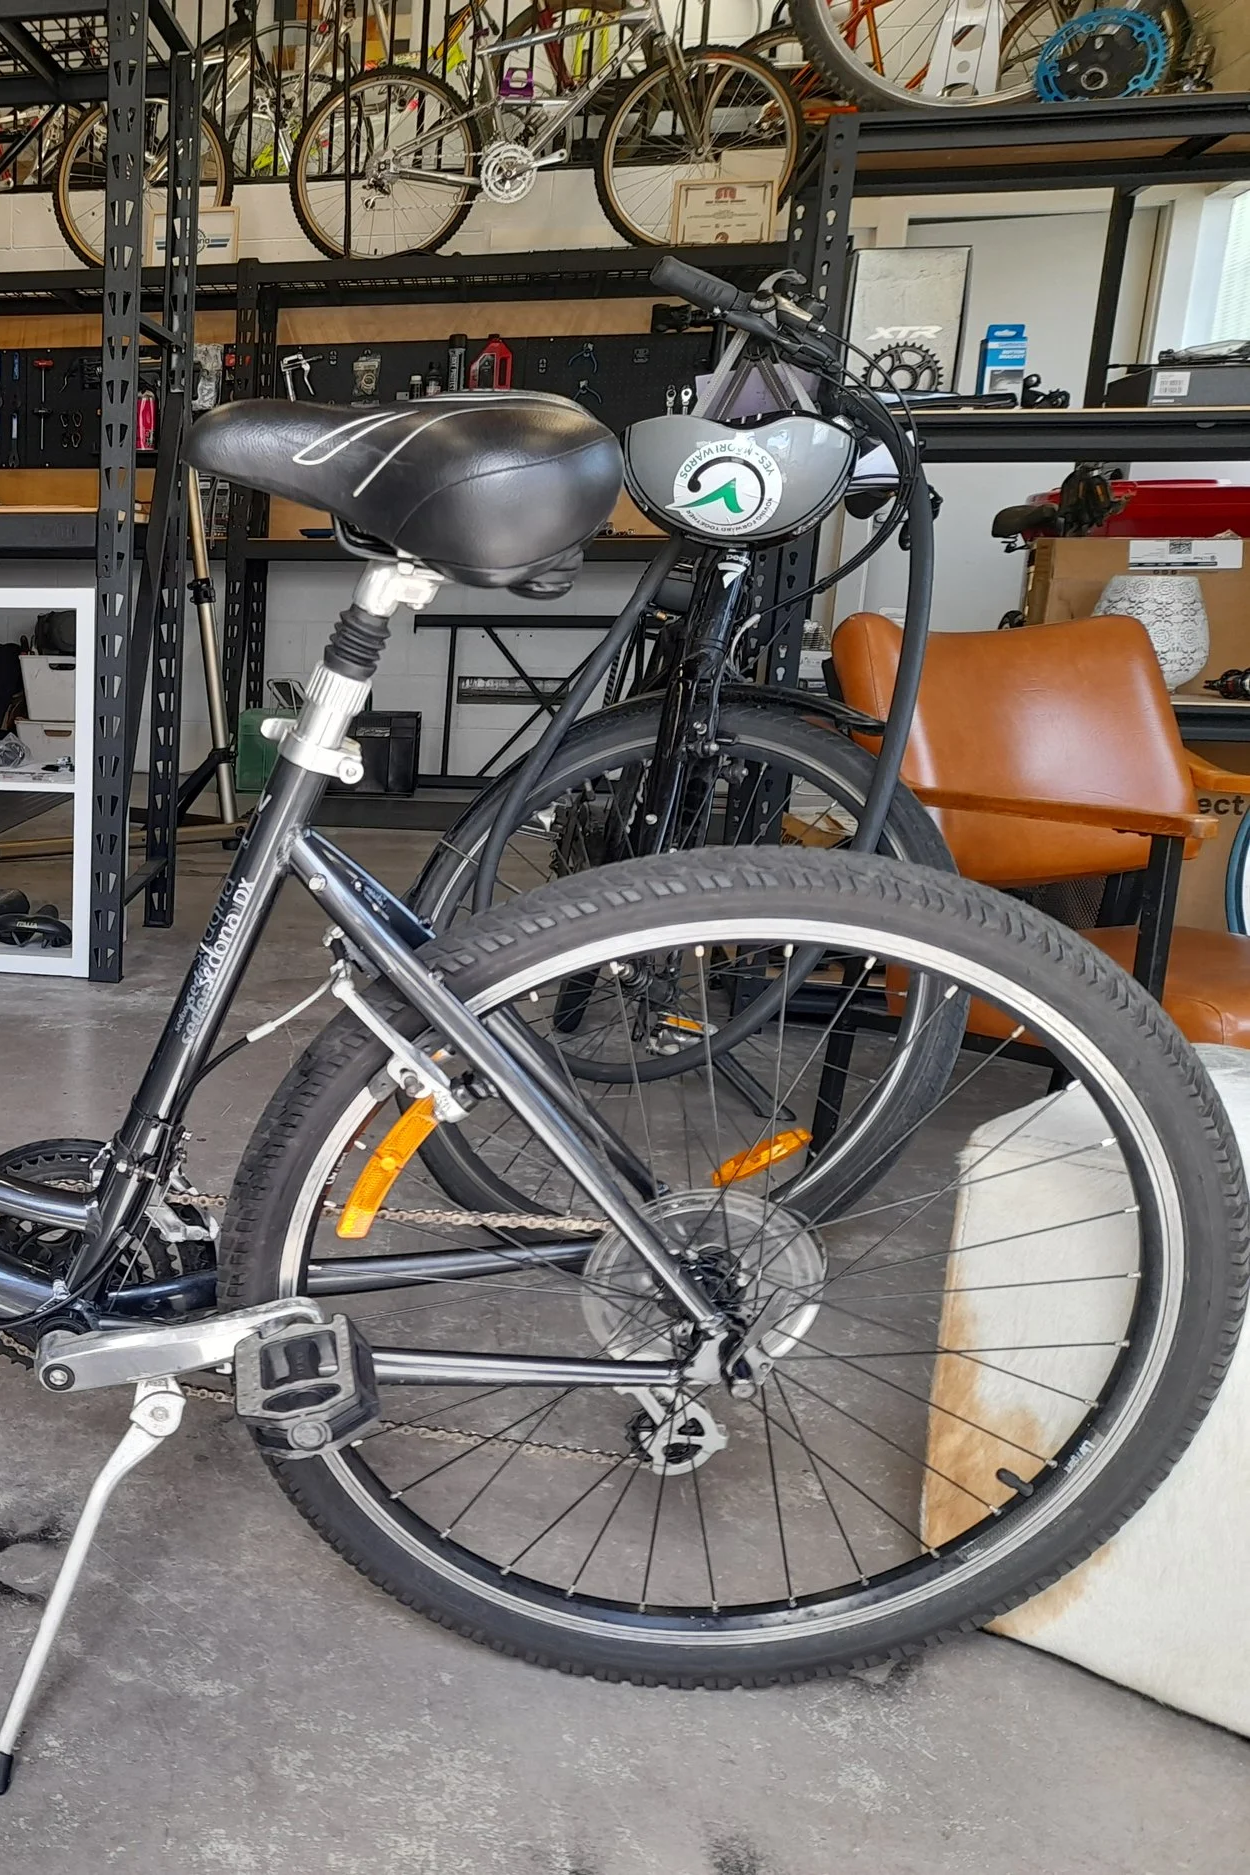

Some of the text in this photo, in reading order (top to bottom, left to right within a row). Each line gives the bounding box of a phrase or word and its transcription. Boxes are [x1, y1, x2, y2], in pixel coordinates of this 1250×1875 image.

[865, 325, 944, 341] XTR
[679, 445, 714, 480] WARDS
[757, 455, 776, 477] YES
[1197, 795, 1245, 816] ect
[232, 876, 256, 908] DX
[198, 911, 240, 989] sedona
